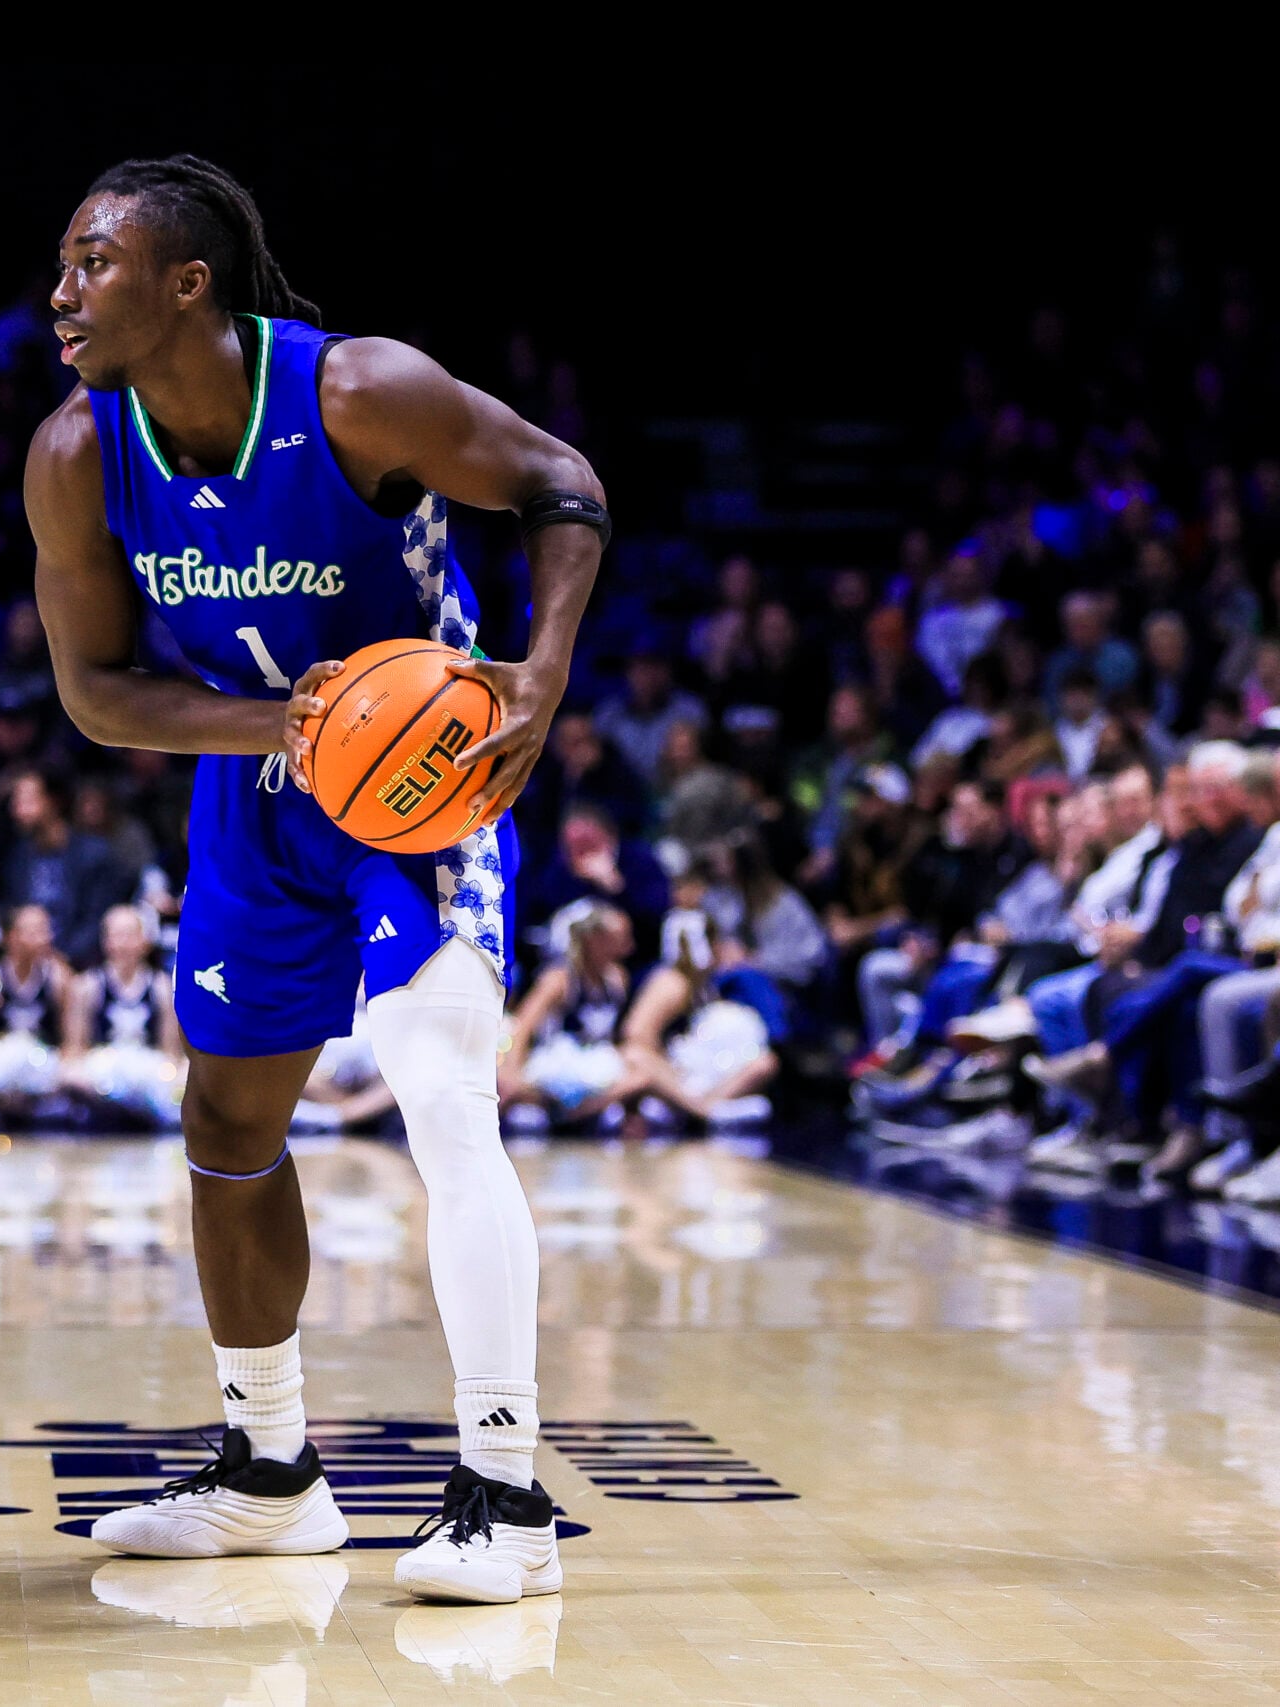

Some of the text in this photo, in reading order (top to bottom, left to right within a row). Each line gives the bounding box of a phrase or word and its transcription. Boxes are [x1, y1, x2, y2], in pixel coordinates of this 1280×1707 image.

[271, 433, 304, 450] SLC
[134, 545, 345, 605] Islanders
[235, 626, 291, 690] 1
[381, 716, 474, 818] ELITE
